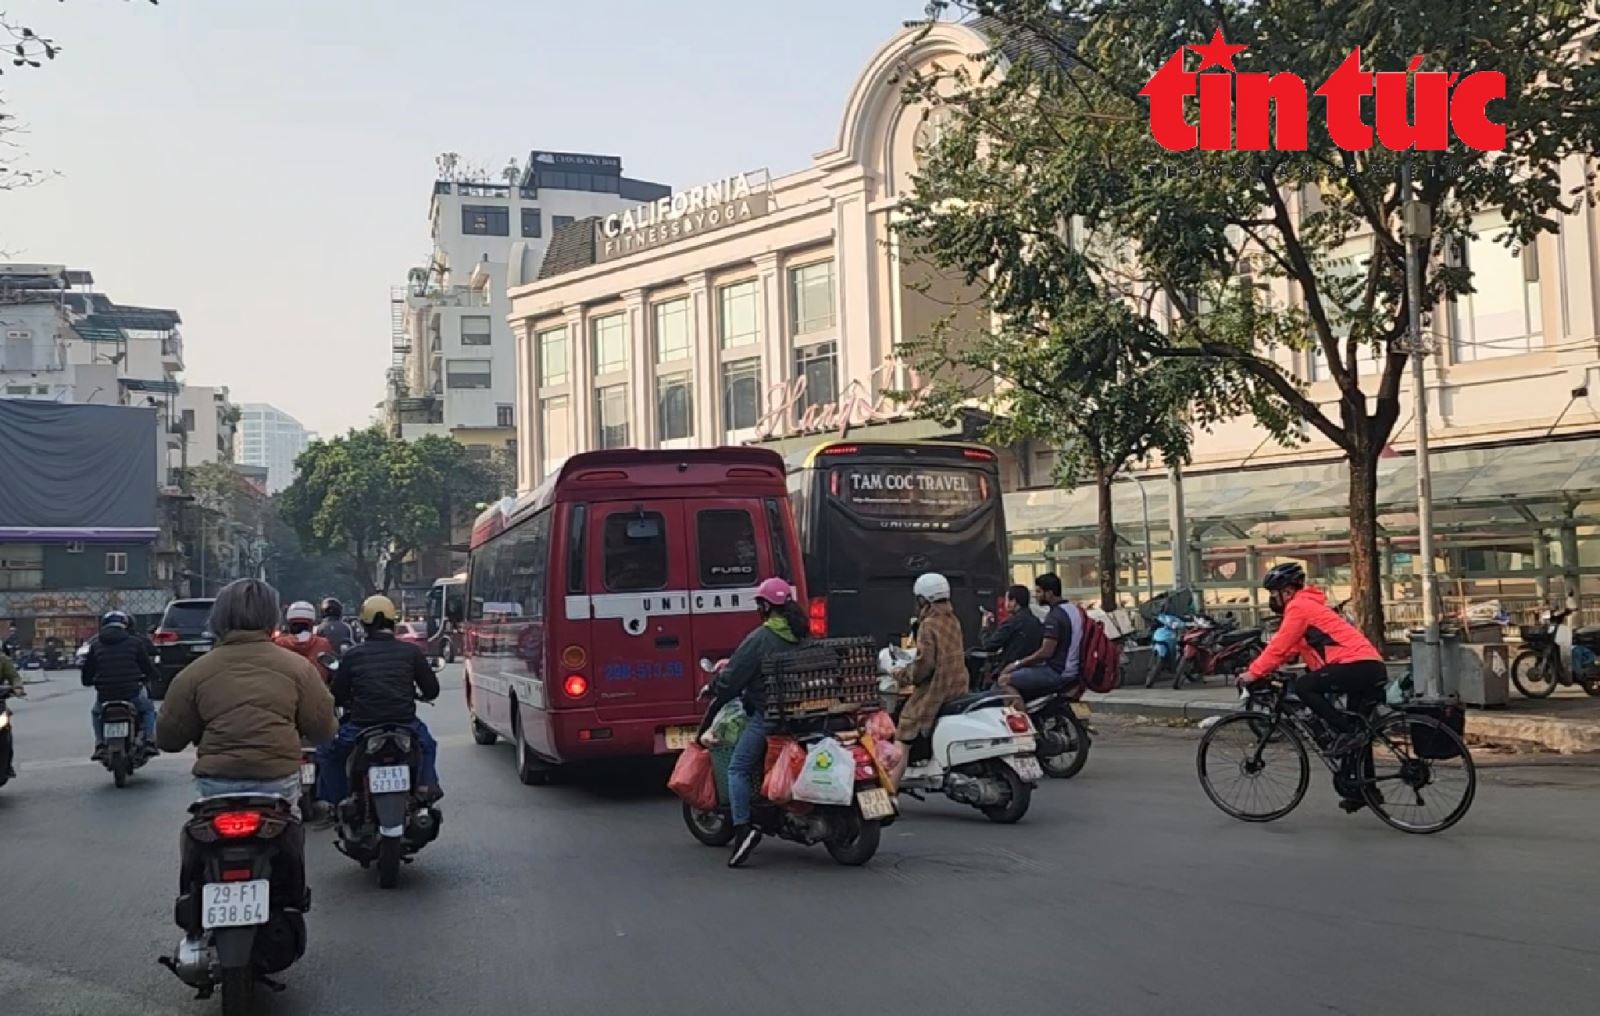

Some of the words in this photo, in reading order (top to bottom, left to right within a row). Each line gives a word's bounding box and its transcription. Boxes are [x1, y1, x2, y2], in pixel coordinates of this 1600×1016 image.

[605, 172, 752, 238] CALIFORNIA
[851, 474, 883, 490] TAM
[885, 474, 914, 490] COC
[916, 474, 970, 492] TRAVEL
[643, 594, 740, 611] UNICAR
[213, 884, 257, 904] 29-F1
[207, 903, 262, 924] 638.64
